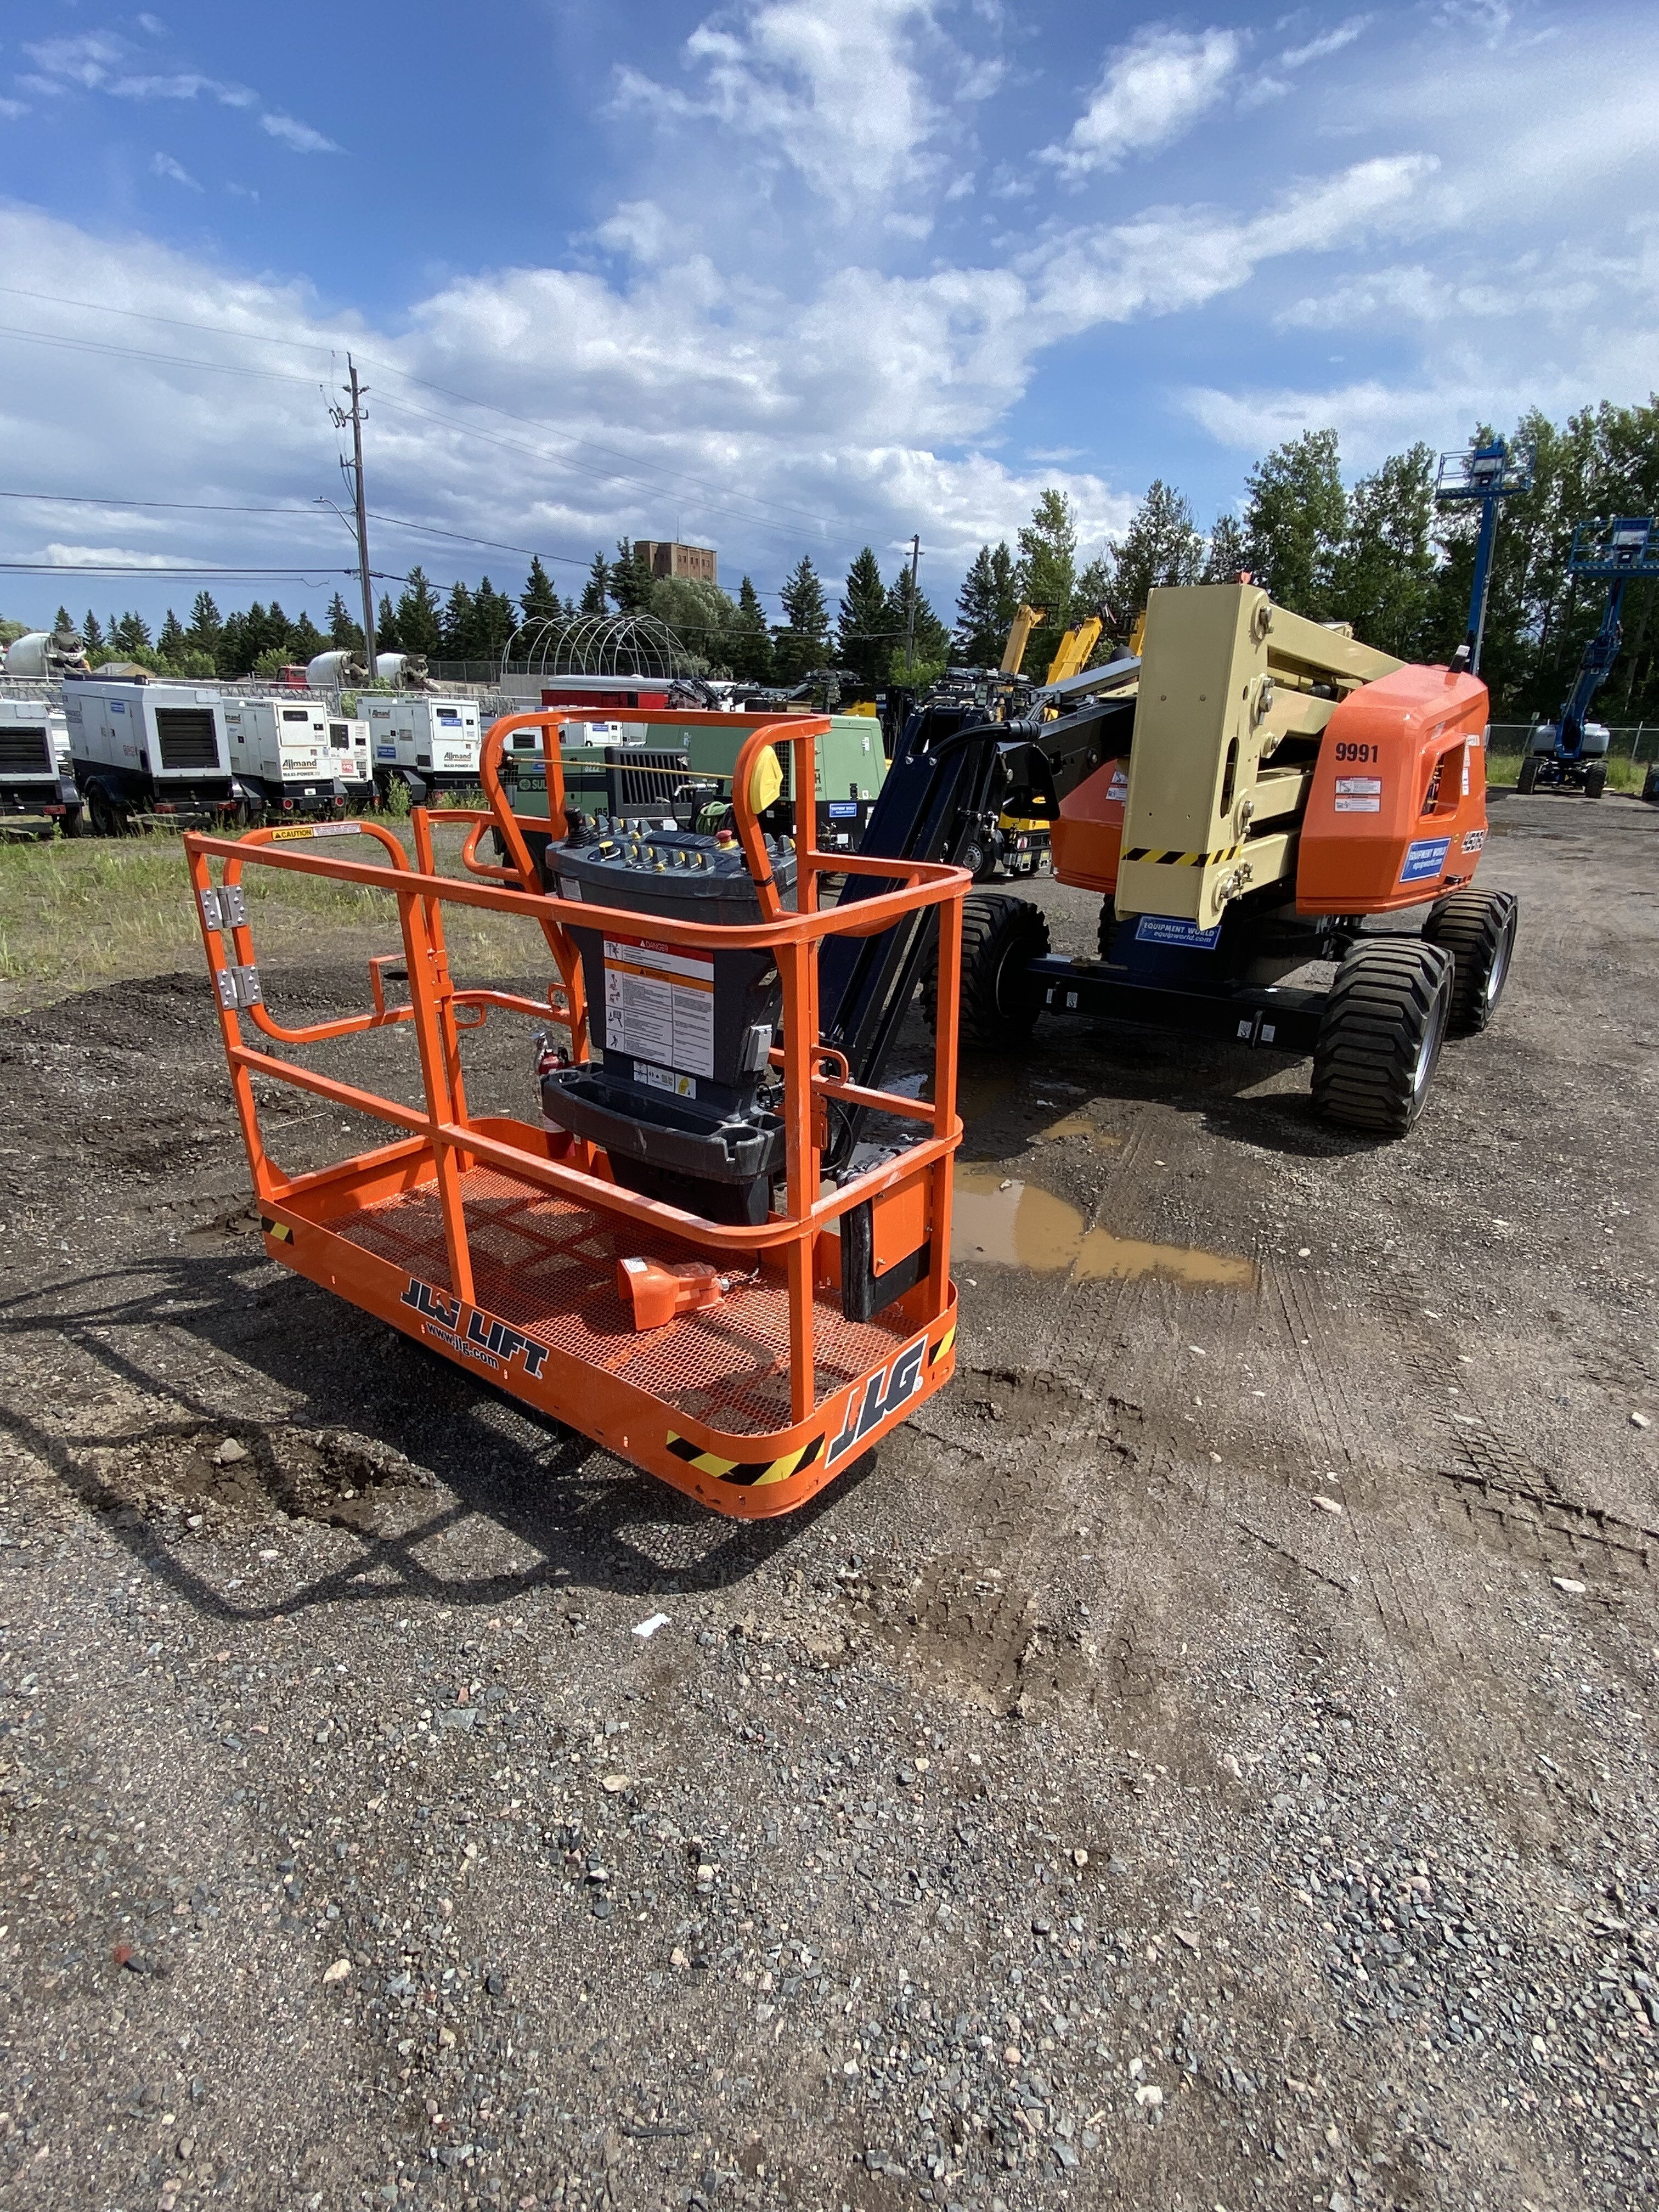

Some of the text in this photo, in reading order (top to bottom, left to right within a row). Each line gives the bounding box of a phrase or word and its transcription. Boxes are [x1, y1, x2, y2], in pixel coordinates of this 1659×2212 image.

[444, 752, 472, 761] Allmand
[1335, 742, 1378, 763] 9991
[283, 759, 317, 770] Allmand
[594, 808, 607, 817] 185
[281, 829, 312, 838] CAUTION
[1408, 846, 1447, 861] EQUIPMENT WORLD
[1144, 922, 1215, 937] EQUIPMENT WORLD
[1154, 931, 1212, 943] equipworld.com
[645, 941, 668, 952] DANGER
[425, 1321, 500, 1370] www.jlg.com
[466, 1308, 550, 1378] LIFT
[824, 1333, 929, 1471] JLG
